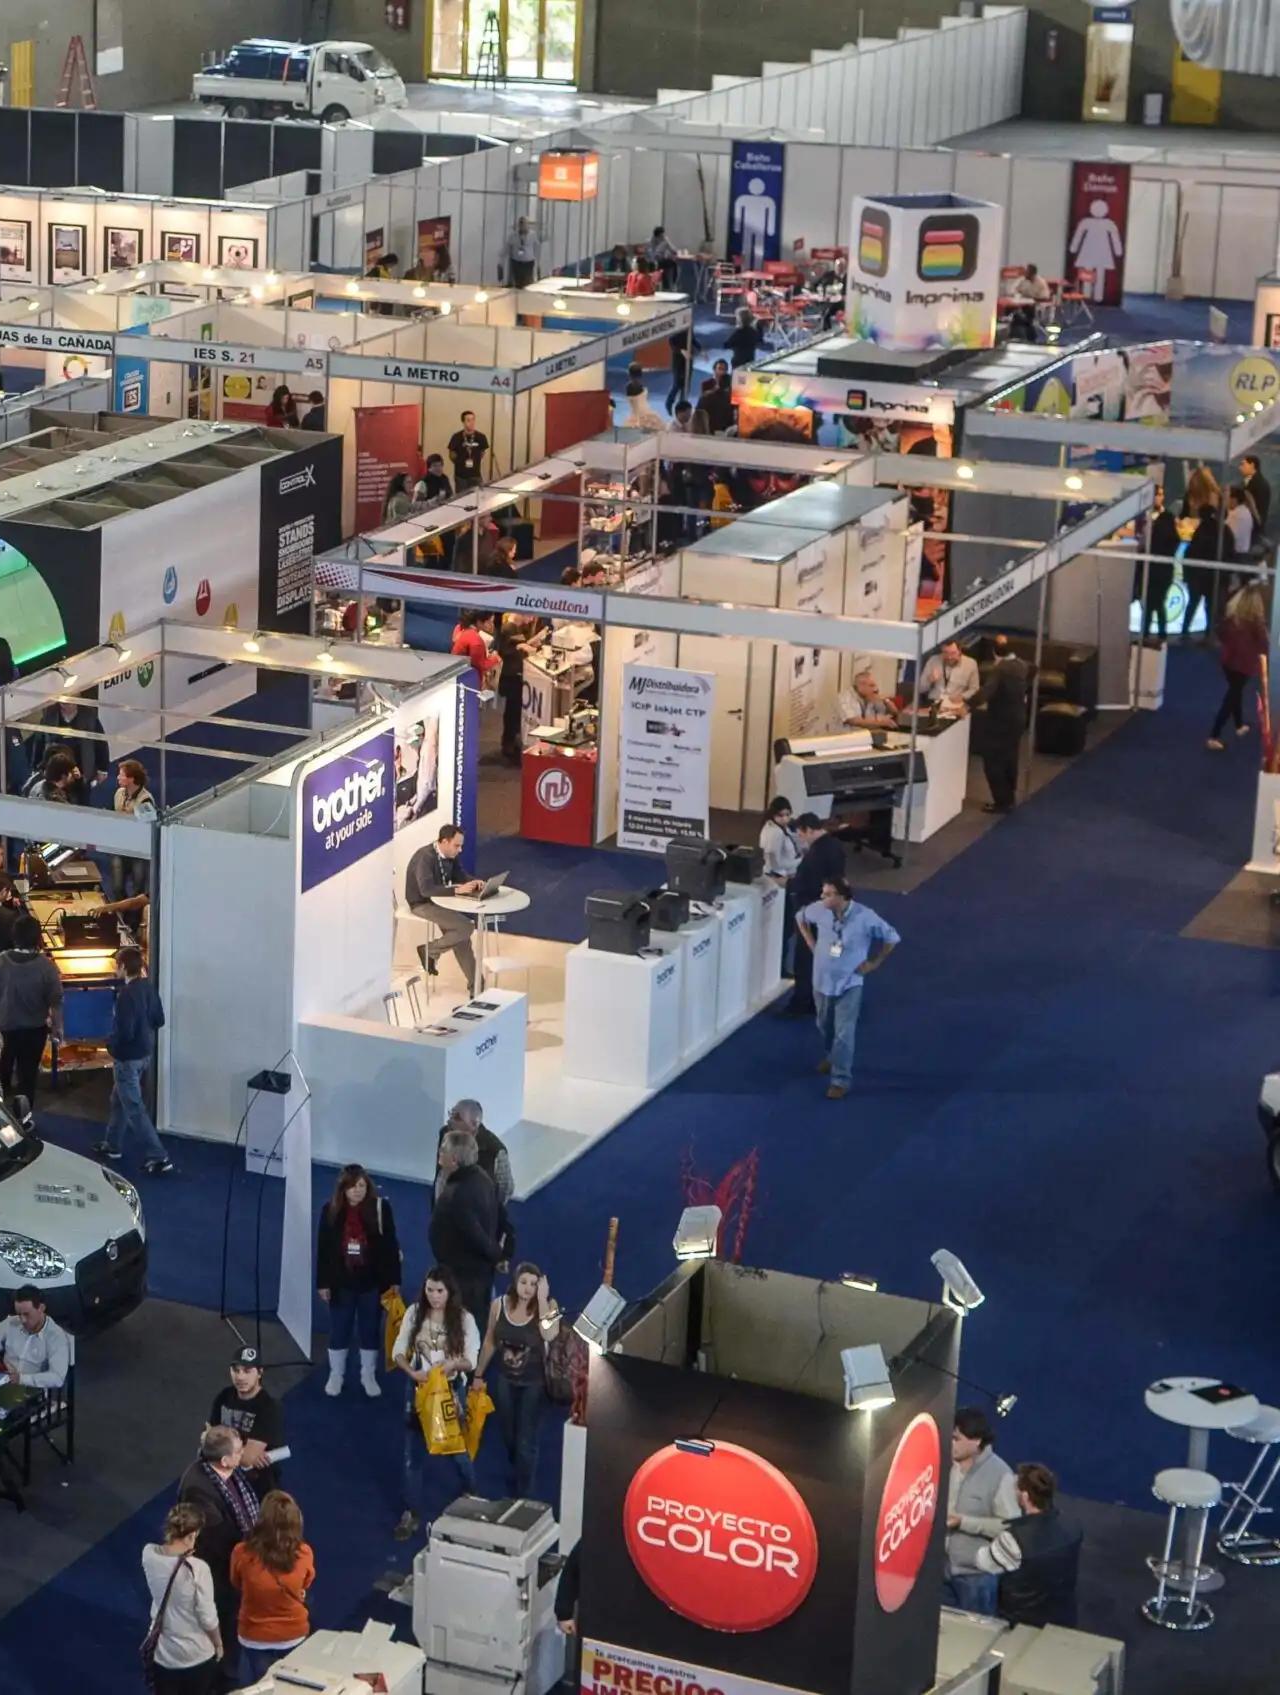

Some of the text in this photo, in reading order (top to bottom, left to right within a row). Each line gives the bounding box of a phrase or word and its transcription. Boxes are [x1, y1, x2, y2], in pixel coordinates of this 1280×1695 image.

[23, 333, 38, 344] de
[41, 334, 52, 345] la
[58, 335, 113, 351] CAÑADA
[194, 348, 324, 370] IES S. 21 A5
[545, 355, 577, 376] LA METRO
[383, 365, 511, 388] LA METRO A4
[1235, 372, 1276, 391] RLP
[278, 521, 315, 548] STANDS
[277, 583, 313, 609] DISPLAYS
[515, 593, 590, 616] nicobuttons
[686, 706, 707, 718] CTP
[313, 763, 385, 833] brother
[325, 808, 373, 850] at your side
[885, 1464, 934, 1527] PROYECTO
[647, 1495, 792, 1543] PROYECTO
[878, 1481, 936, 1564] COLOR
[636, 1515, 800, 1579] COLOR
[595, 1648, 607, 1658] Te
